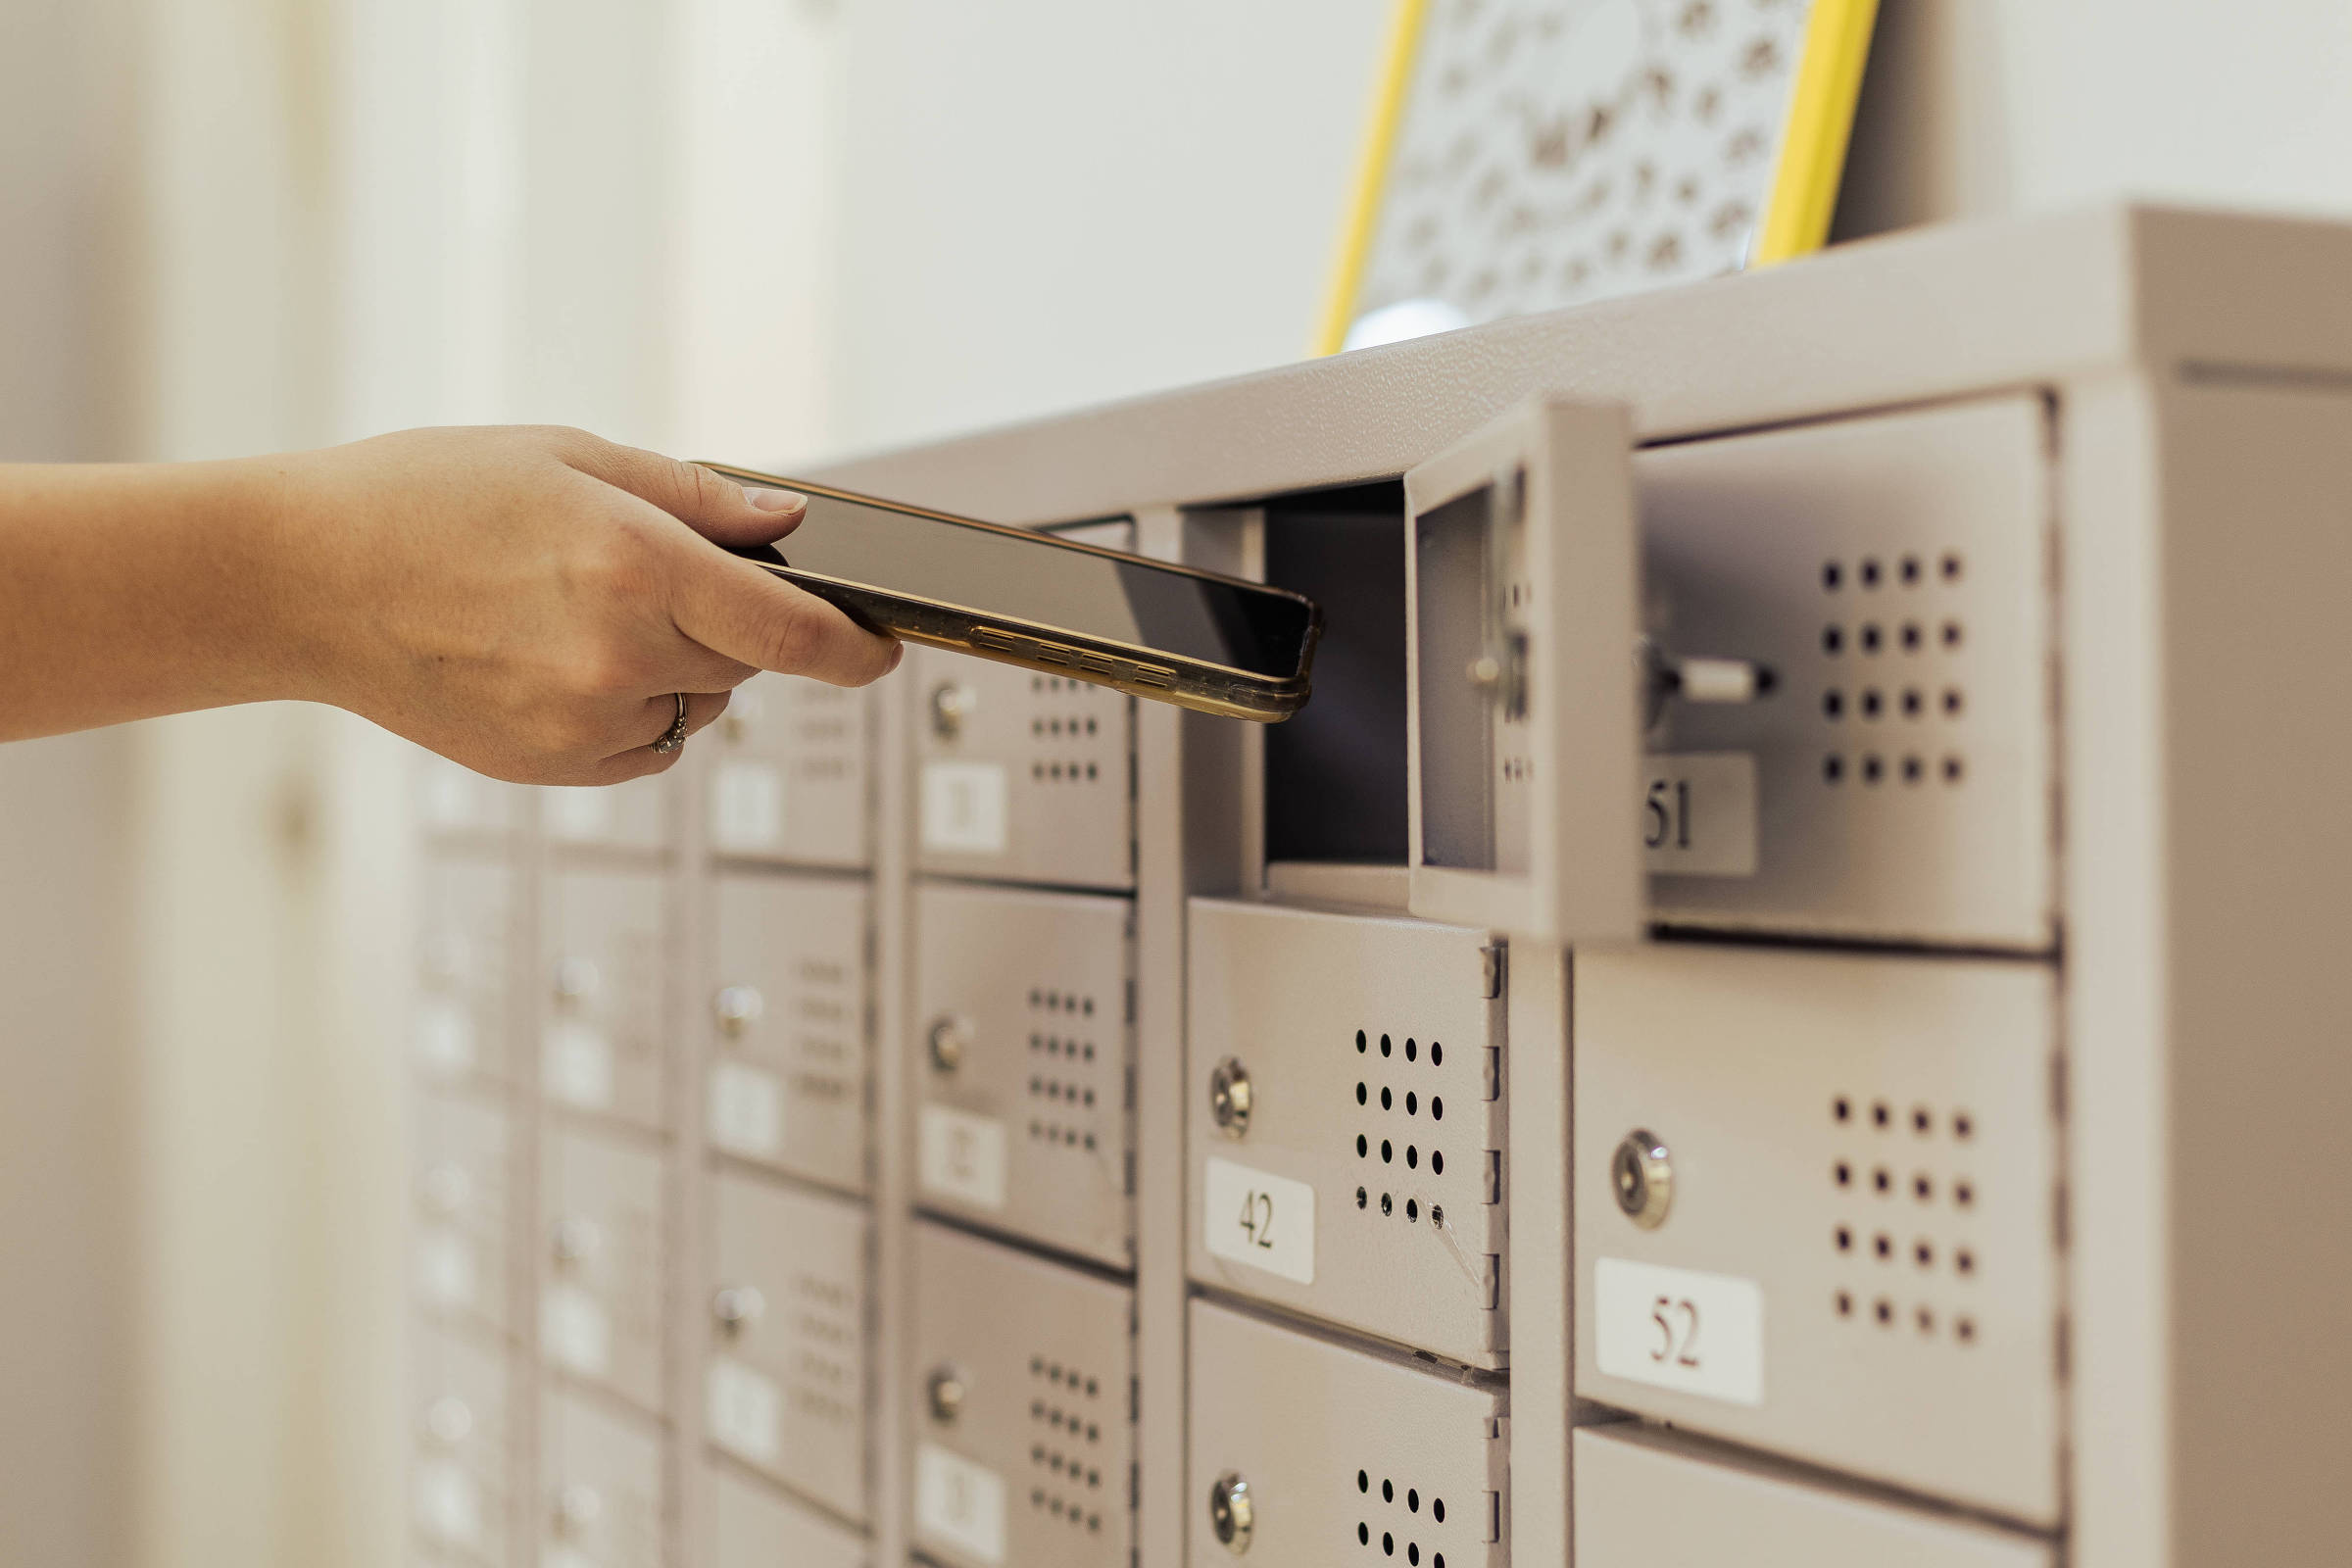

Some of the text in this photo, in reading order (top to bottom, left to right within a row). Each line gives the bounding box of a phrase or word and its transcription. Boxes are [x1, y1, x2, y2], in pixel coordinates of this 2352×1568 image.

[1644, 780, 1690, 850] 51
[1239, 1189, 1272, 1249] 42
[1650, 1295, 1701, 1367] 52
